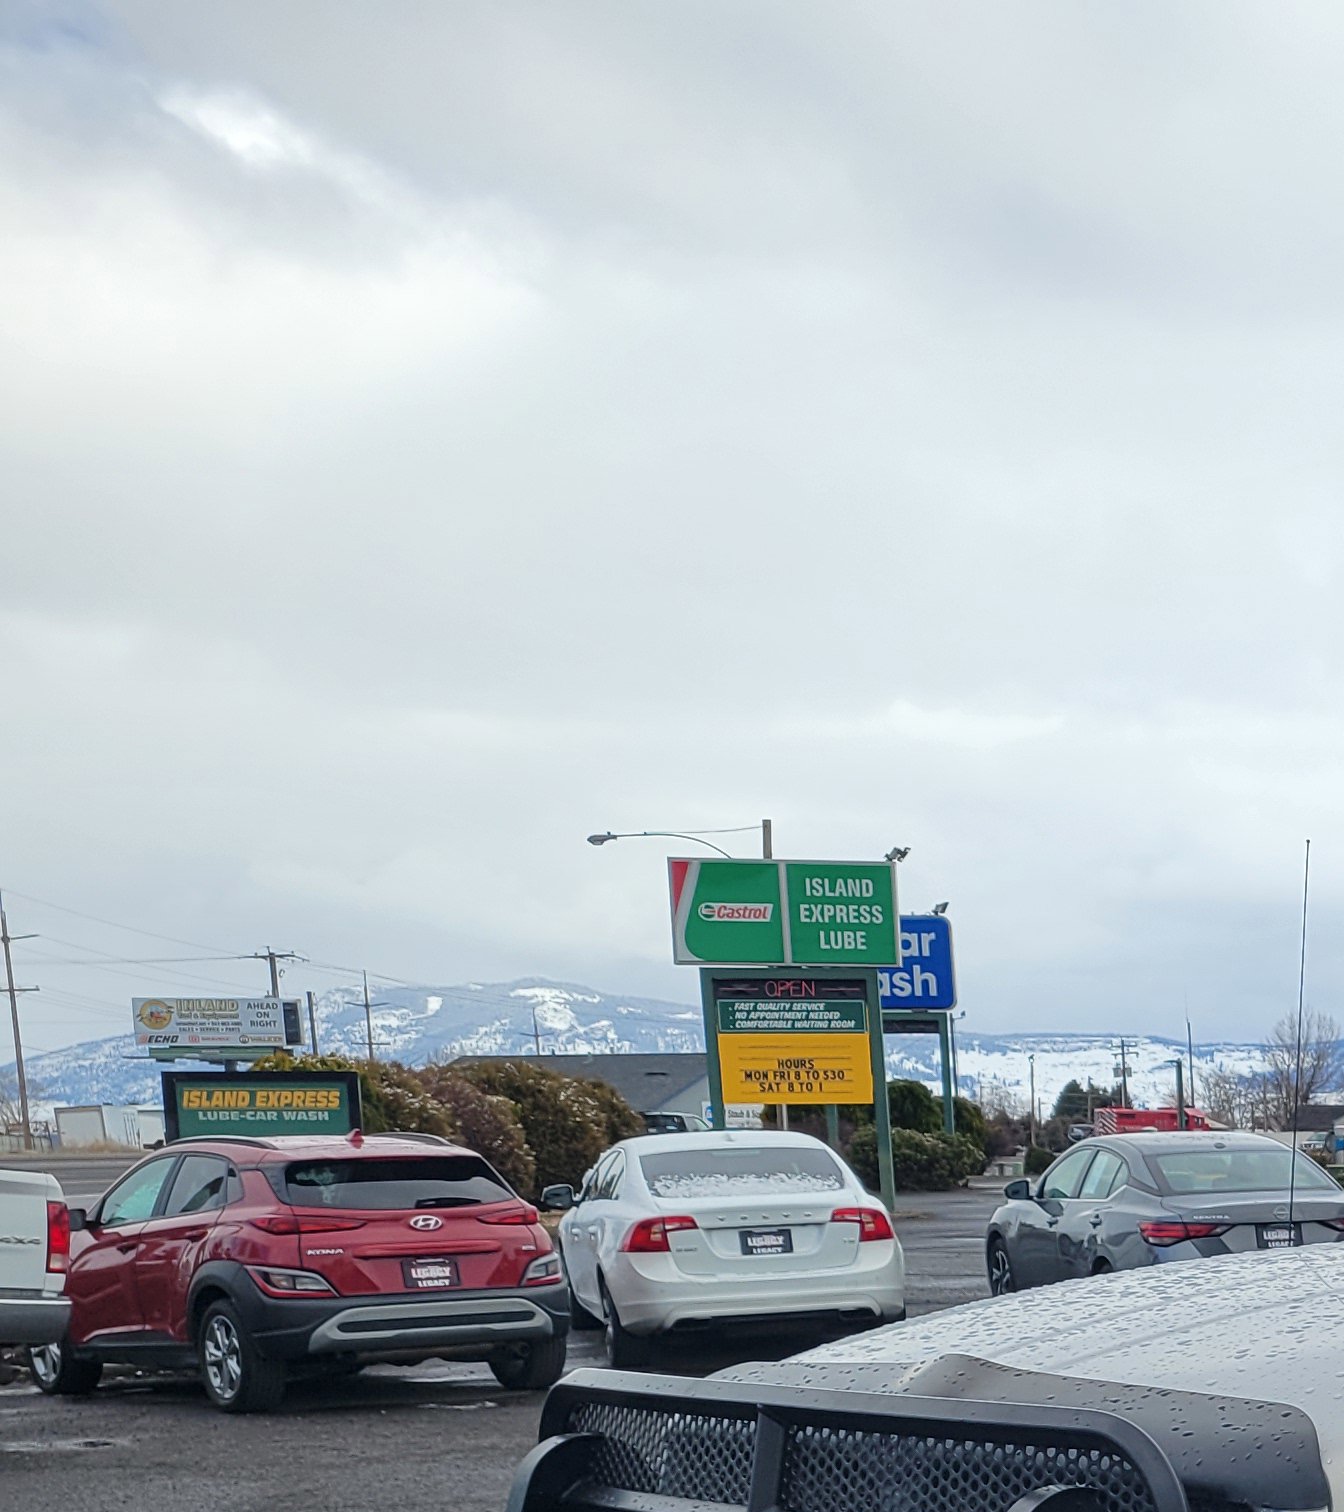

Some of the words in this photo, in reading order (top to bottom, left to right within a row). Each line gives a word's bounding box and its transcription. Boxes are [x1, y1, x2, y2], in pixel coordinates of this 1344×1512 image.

[805, 878, 874, 897] ISLAND
[717, 905, 769, 920] Castrol
[799, 904, 884, 924] EXPRESS
[820, 930, 867, 949] LUBE
[899, 931, 936, 957] ar
[879, 964, 938, 997] ash
[764, 981, 816, 998] OPEN
[176, 999, 239, 1012] INLAND
[246, 1002, 278, 1010] AHEAD
[734, 1002, 753, 1011] FAST
[756, 1002, 791, 1011] QUALITY
[792, 1002, 826, 1011] SERVICE
[734, 1011, 746, 1019] NO
[748, 1011, 806, 1020] APPOINTMENT
[808, 1011, 841, 1020] NEEDED
[249, 1020, 277, 1028] RIGHT
[735, 1020, 793, 1029] COMFORTABLE
[794, 1020, 830, 1029] WAITING
[830, 1020, 856, 1029] ROOM
[147, 1035, 179, 1044] ECHO
[777, 1059, 815, 1070] HOURS
[744, 1070, 769, 1081] MON
[773, 1071, 791, 1081] FRI
[794, 1071, 801, 1080] 8
[806, 1071, 820, 1080] TO
[823, 1070, 845, 1080] 530
[759, 1082, 781, 1092] SAT
[787, 1082, 795, 1092] 8
[800, 1082, 814, 1092] TO
[182, 1090, 251, 1109] ISLAND
[255, 1090, 341, 1109] EXPRESS
[198, 1111, 278, 1121] LUBE-CAR
[282, 1111, 330, 1121] WASH
[717, 1211, 813, 1222] VOLVO
[306, 1248, 344, 1256] KONA
[752, 1247, 782, 1255] LEGACY
[411, 1266, 451, 1279] LEGACY
[417, 1279, 450, 1288] LEGACY
